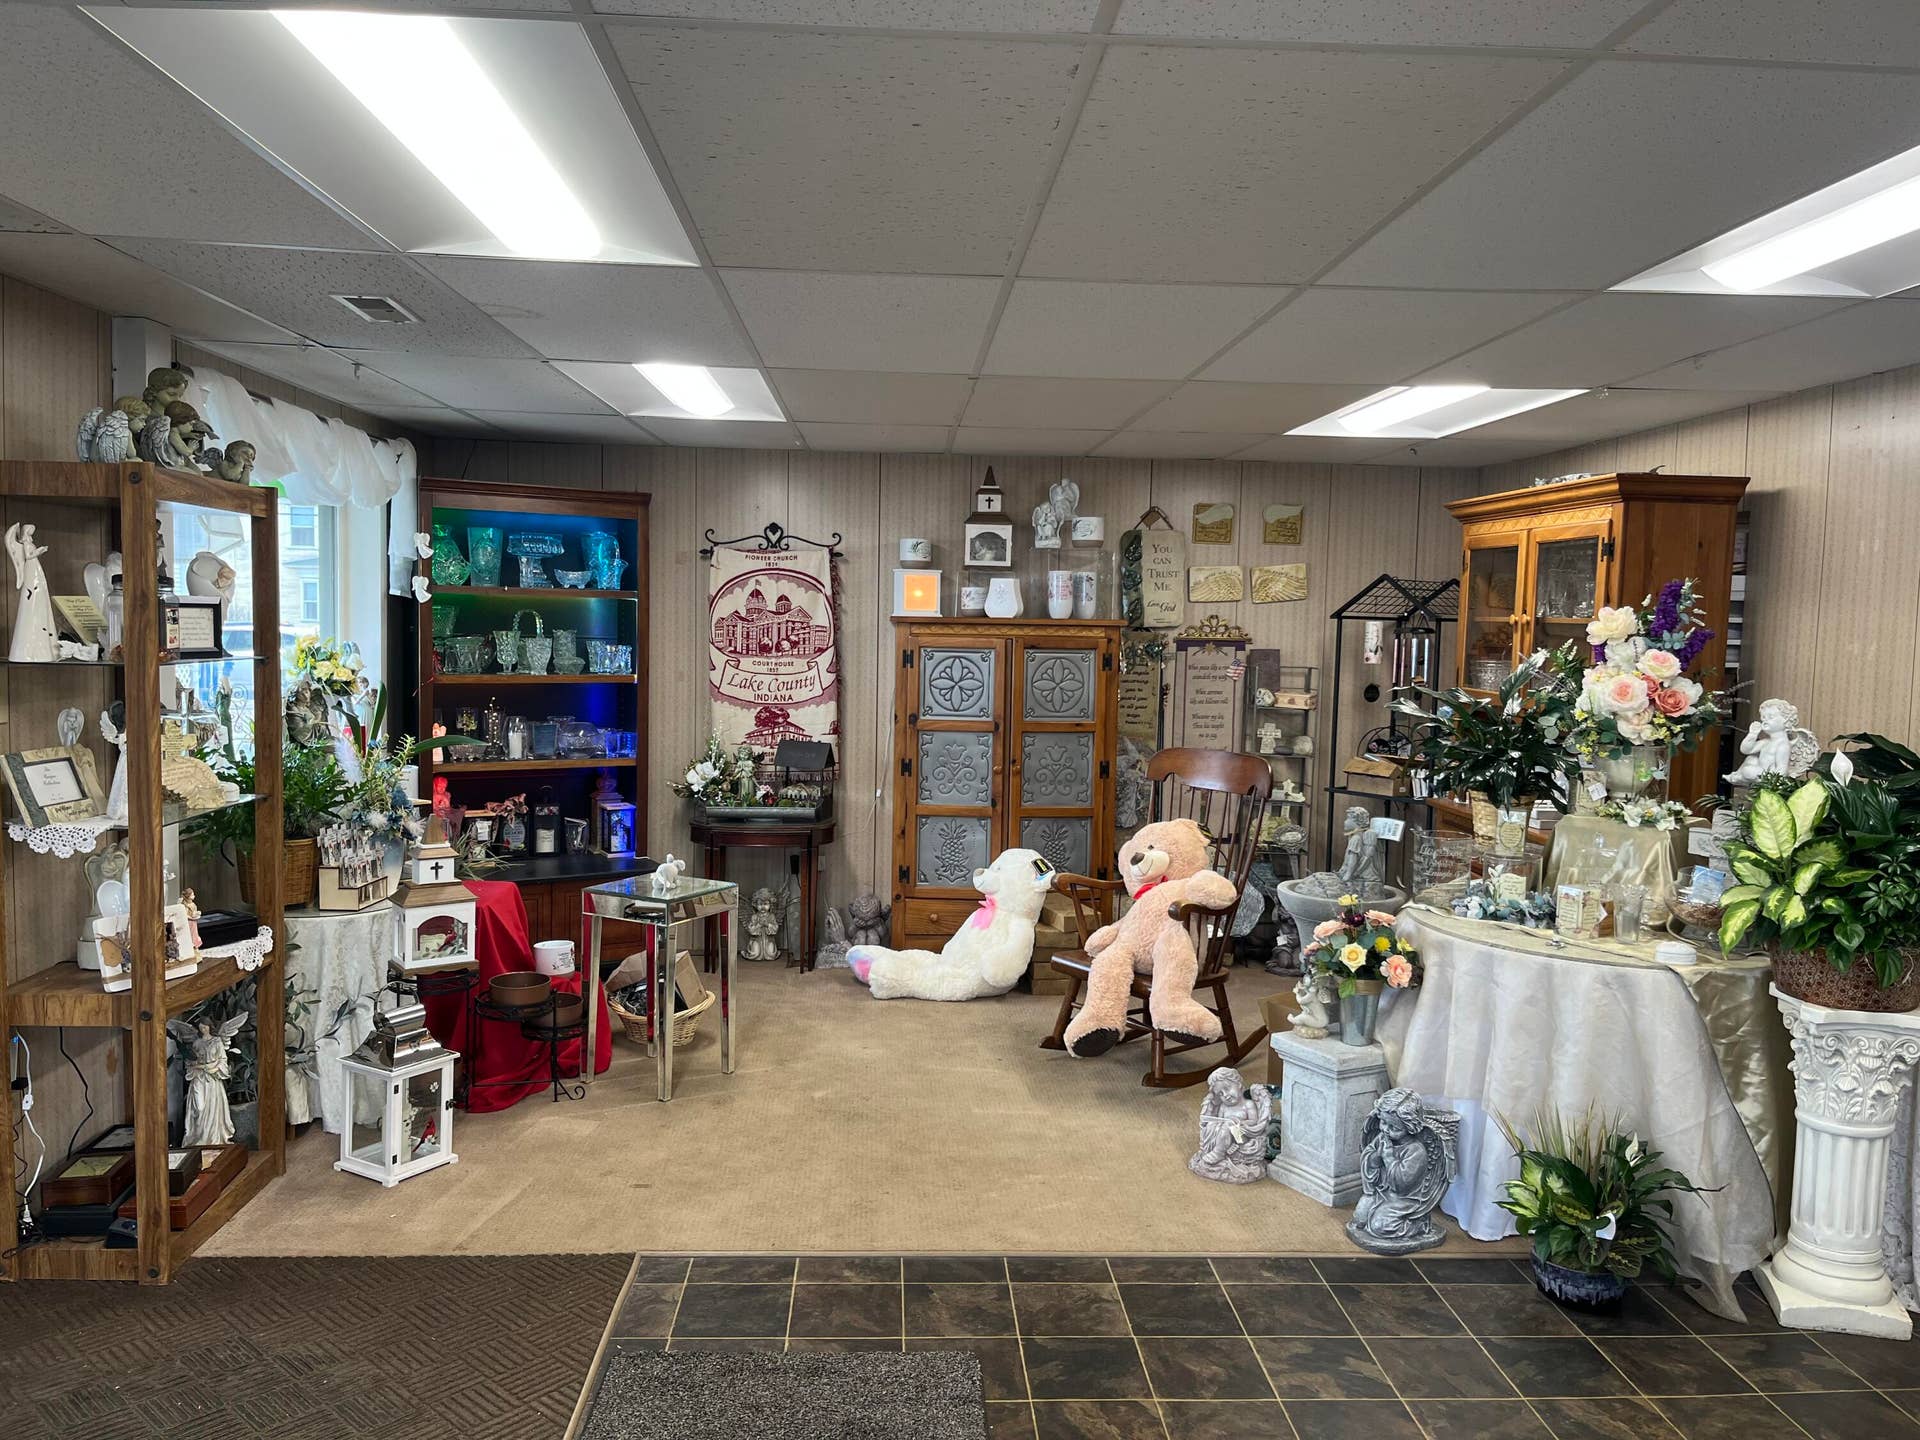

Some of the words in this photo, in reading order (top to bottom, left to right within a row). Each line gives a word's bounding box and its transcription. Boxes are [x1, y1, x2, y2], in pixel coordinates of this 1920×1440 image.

[1152, 544, 1173, 554] YOU
[1147, 568, 1180, 578] TRUST
[727, 673, 764, 692] Lake
[768, 675, 816, 693] County
[754, 693, 794, 702] INDIANA
